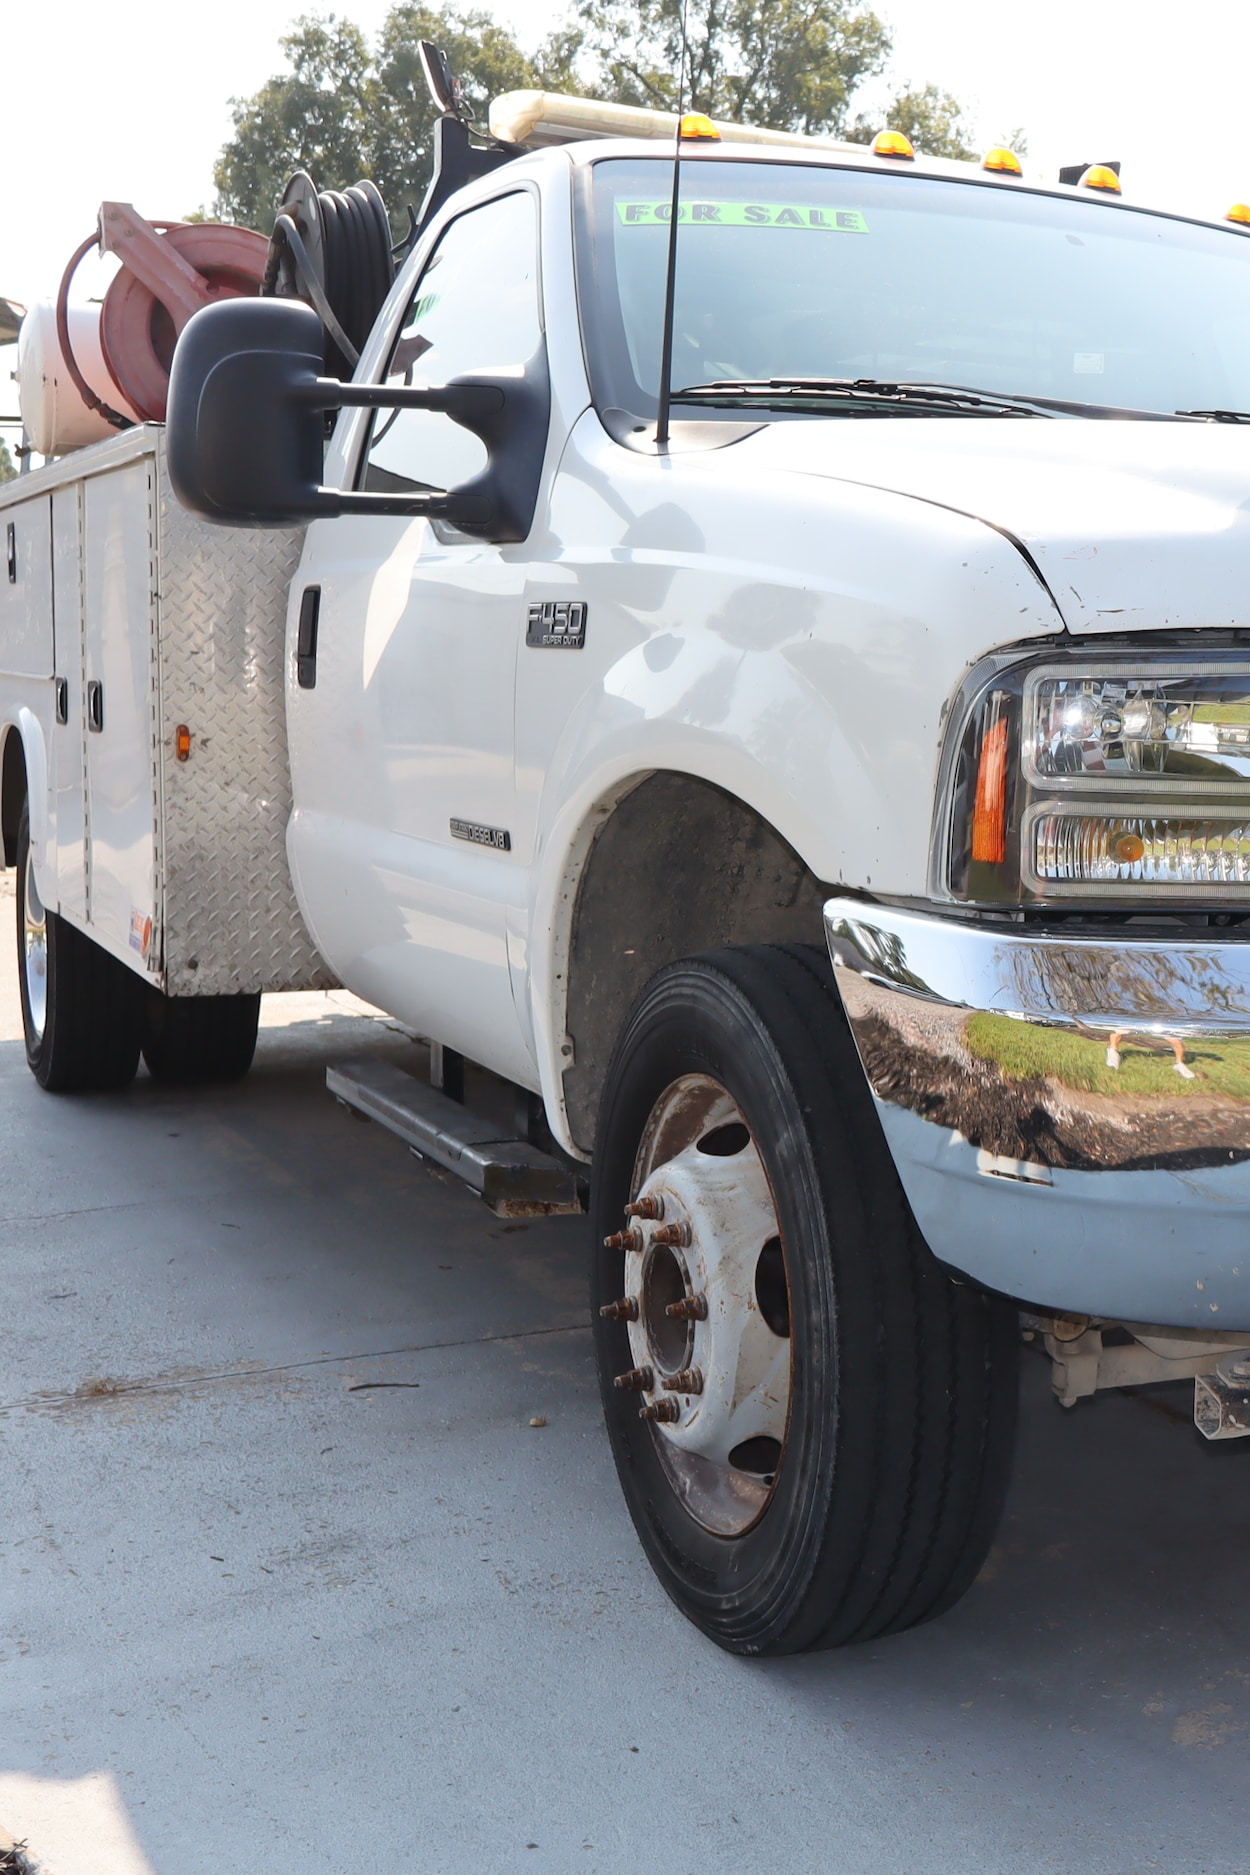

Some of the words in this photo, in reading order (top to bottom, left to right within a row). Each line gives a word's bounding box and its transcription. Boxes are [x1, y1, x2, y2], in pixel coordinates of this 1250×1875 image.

[625, 204, 720, 222] FOR
[744, 205, 859, 229] SALE
[526, 603, 583, 634] F-450
[543, 635, 562, 645] SUPER
[563, 635, 581, 645] DUTY
